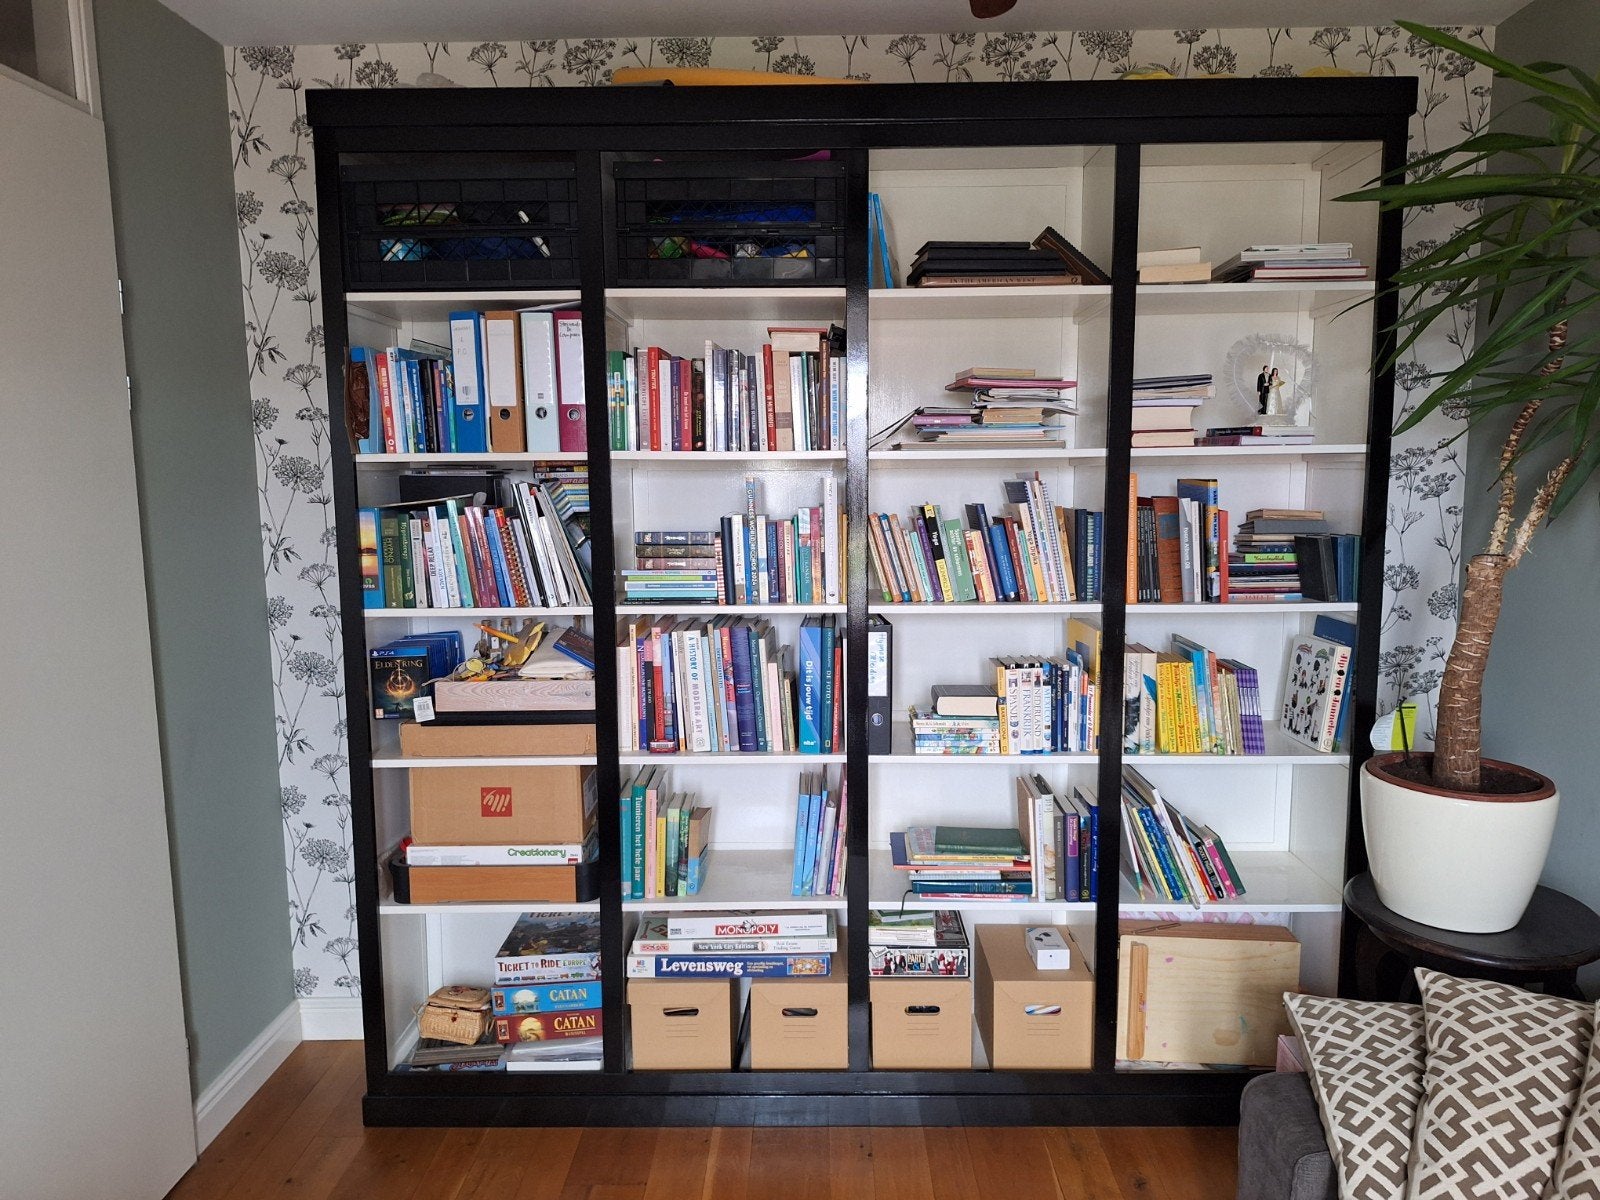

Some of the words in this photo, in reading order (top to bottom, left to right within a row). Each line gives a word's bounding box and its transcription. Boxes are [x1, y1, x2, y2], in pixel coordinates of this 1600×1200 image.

[427, 546, 435, 562] RELAX
[1030, 546, 1038, 566] Dipika
[875, 633, 886, 662] Hypnose
[374, 660, 400, 670] ELDEN
[402, 660, 423, 668] RING
[692, 672, 698, 681] OF
[826, 670, 831, 679] DE
[1335, 677, 1342, 688] en
[692, 683, 700, 716] MODERN
[804, 684, 814, 703] jouw
[1009, 688, 1018, 722] SPANJE
[804, 706, 814, 720] tijd
[1022, 690, 1031, 737] FRANKRIJK
[507, 848, 566, 858] Creationary
[717, 926, 776, 934] MONOPOLY
[908, 954, 926, 962] PARTY
[498, 962, 530, 972] TICKET
[540, 959, 561, 968] RIDE
[661, 958, 743, 975] Levensweg
[550, 988, 587, 1001] CATAN
[554, 1015, 596, 1030] CATAN
